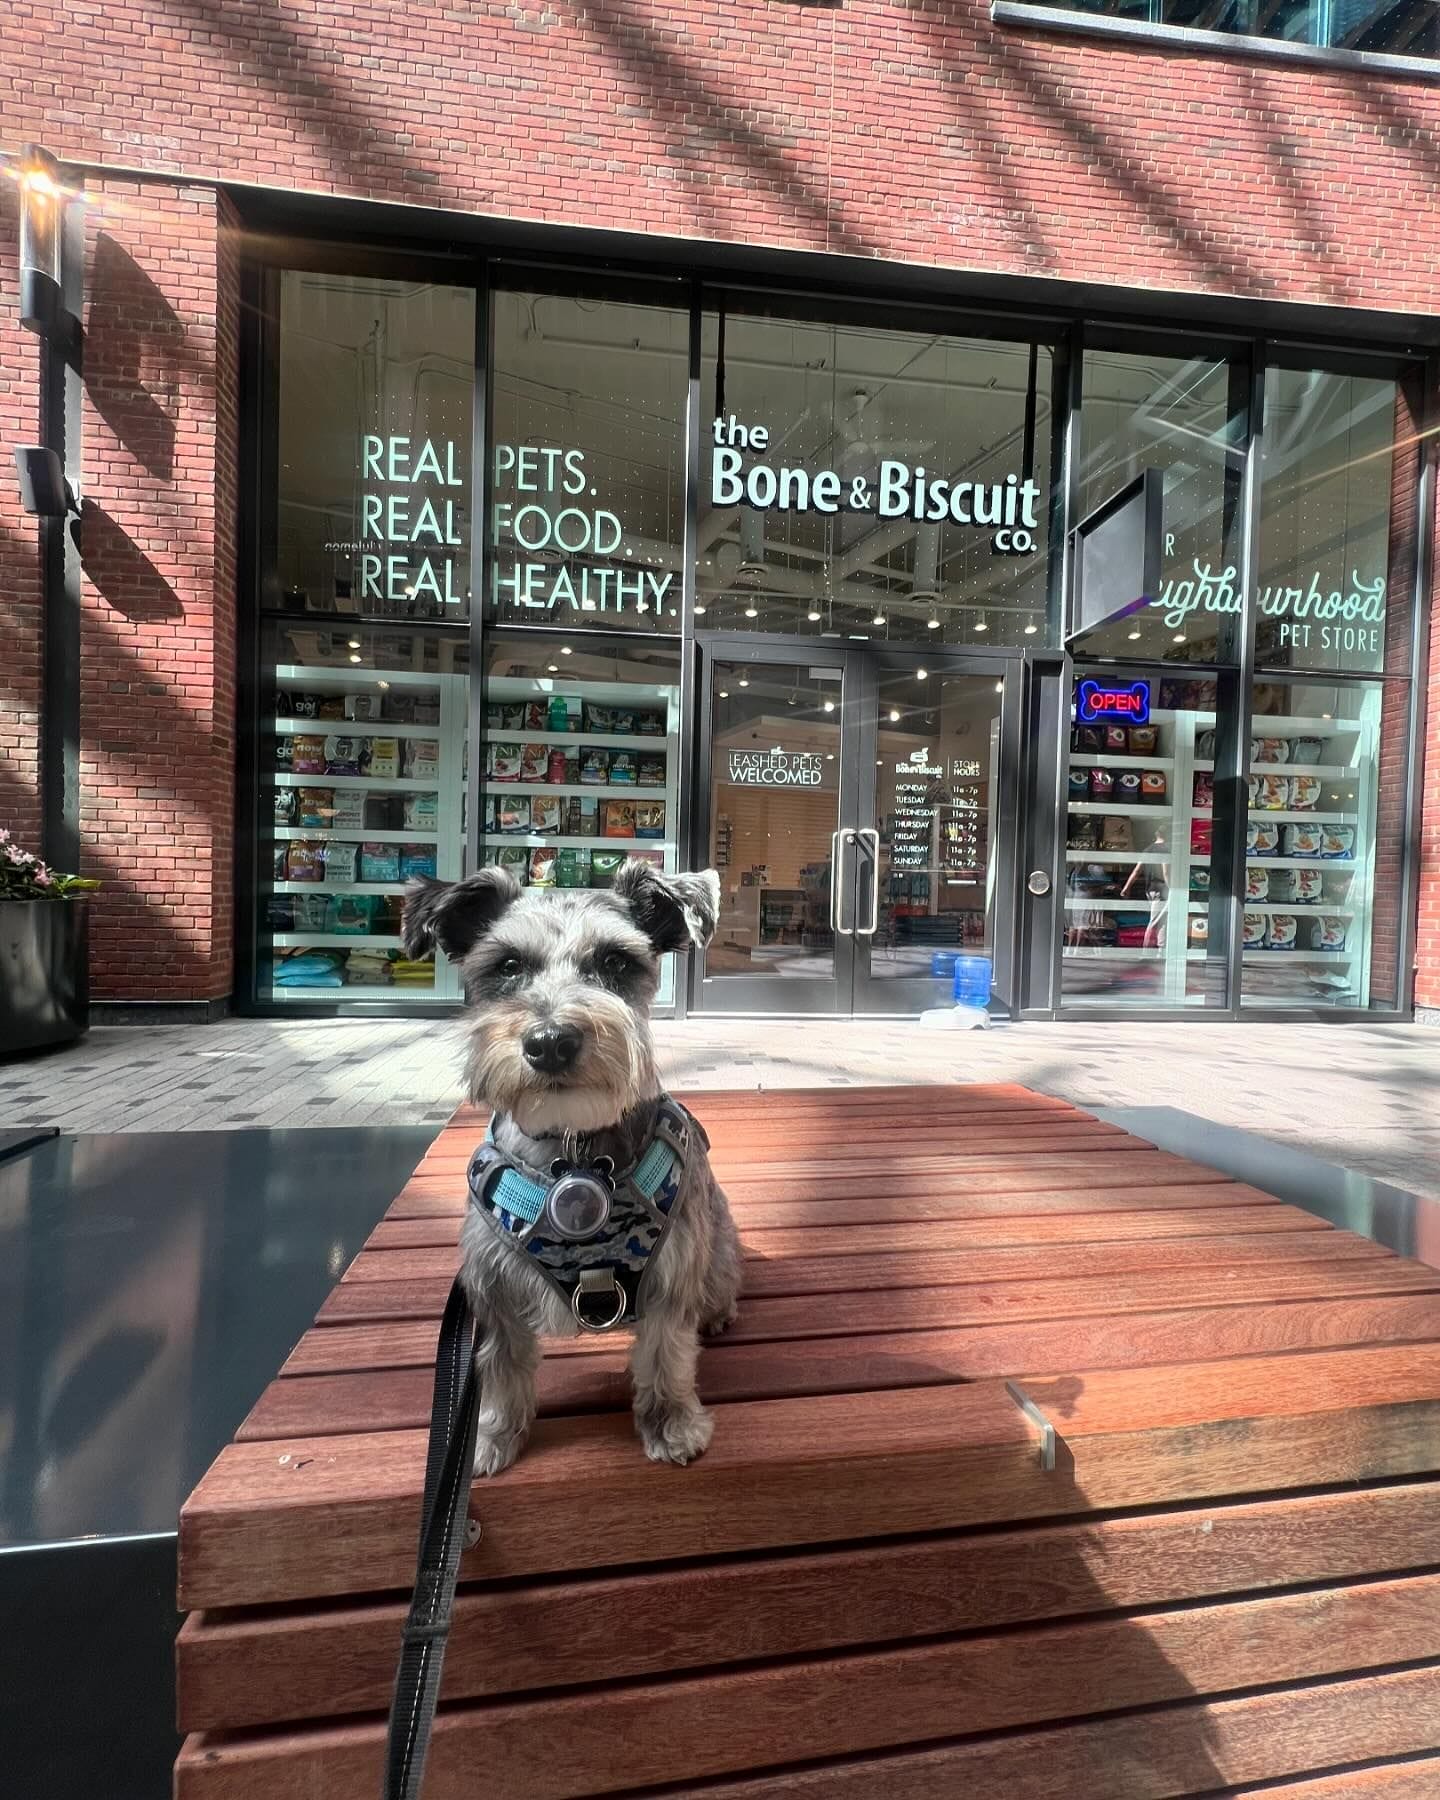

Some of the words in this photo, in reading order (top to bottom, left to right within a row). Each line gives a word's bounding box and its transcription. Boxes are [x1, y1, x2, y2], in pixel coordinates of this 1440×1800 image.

[713, 415, 768, 448] the
[363, 435, 462, 486] REAL
[495, 445, 597, 496] PETS.
[712, 448, 841, 512] Bone
[850, 476, 871, 509] &
[879, 461, 1040, 528] Biscuit
[362, 495, 462, 545] REAL
[493, 504, 633, 556] FOOD.
[995, 529, 1037, 551] co.
[361, 554, 461, 604] REAL
[492, 562, 677, 617] HEALTHY.
[1280, 623, 1311, 648] PET
[1321, 626, 1378, 652] STORE
[1090, 693, 1140, 711] OPEN
[729, 754, 788, 769] LEASHED
[792, 756, 822, 770] PETS
[729, 767, 822, 785] WELCOMED
[953, 769, 980, 777] HOURS
[895, 784, 928, 792] MONDAY
[895, 796, 926, 804] TUESDAY
[894, 808, 938, 817] WEDNESDAY
[894, 821, 930, 829] THURSDAY
[894, 845, 929, 853] SATURDAY
[893, 857, 923, 865] SUNDAY
